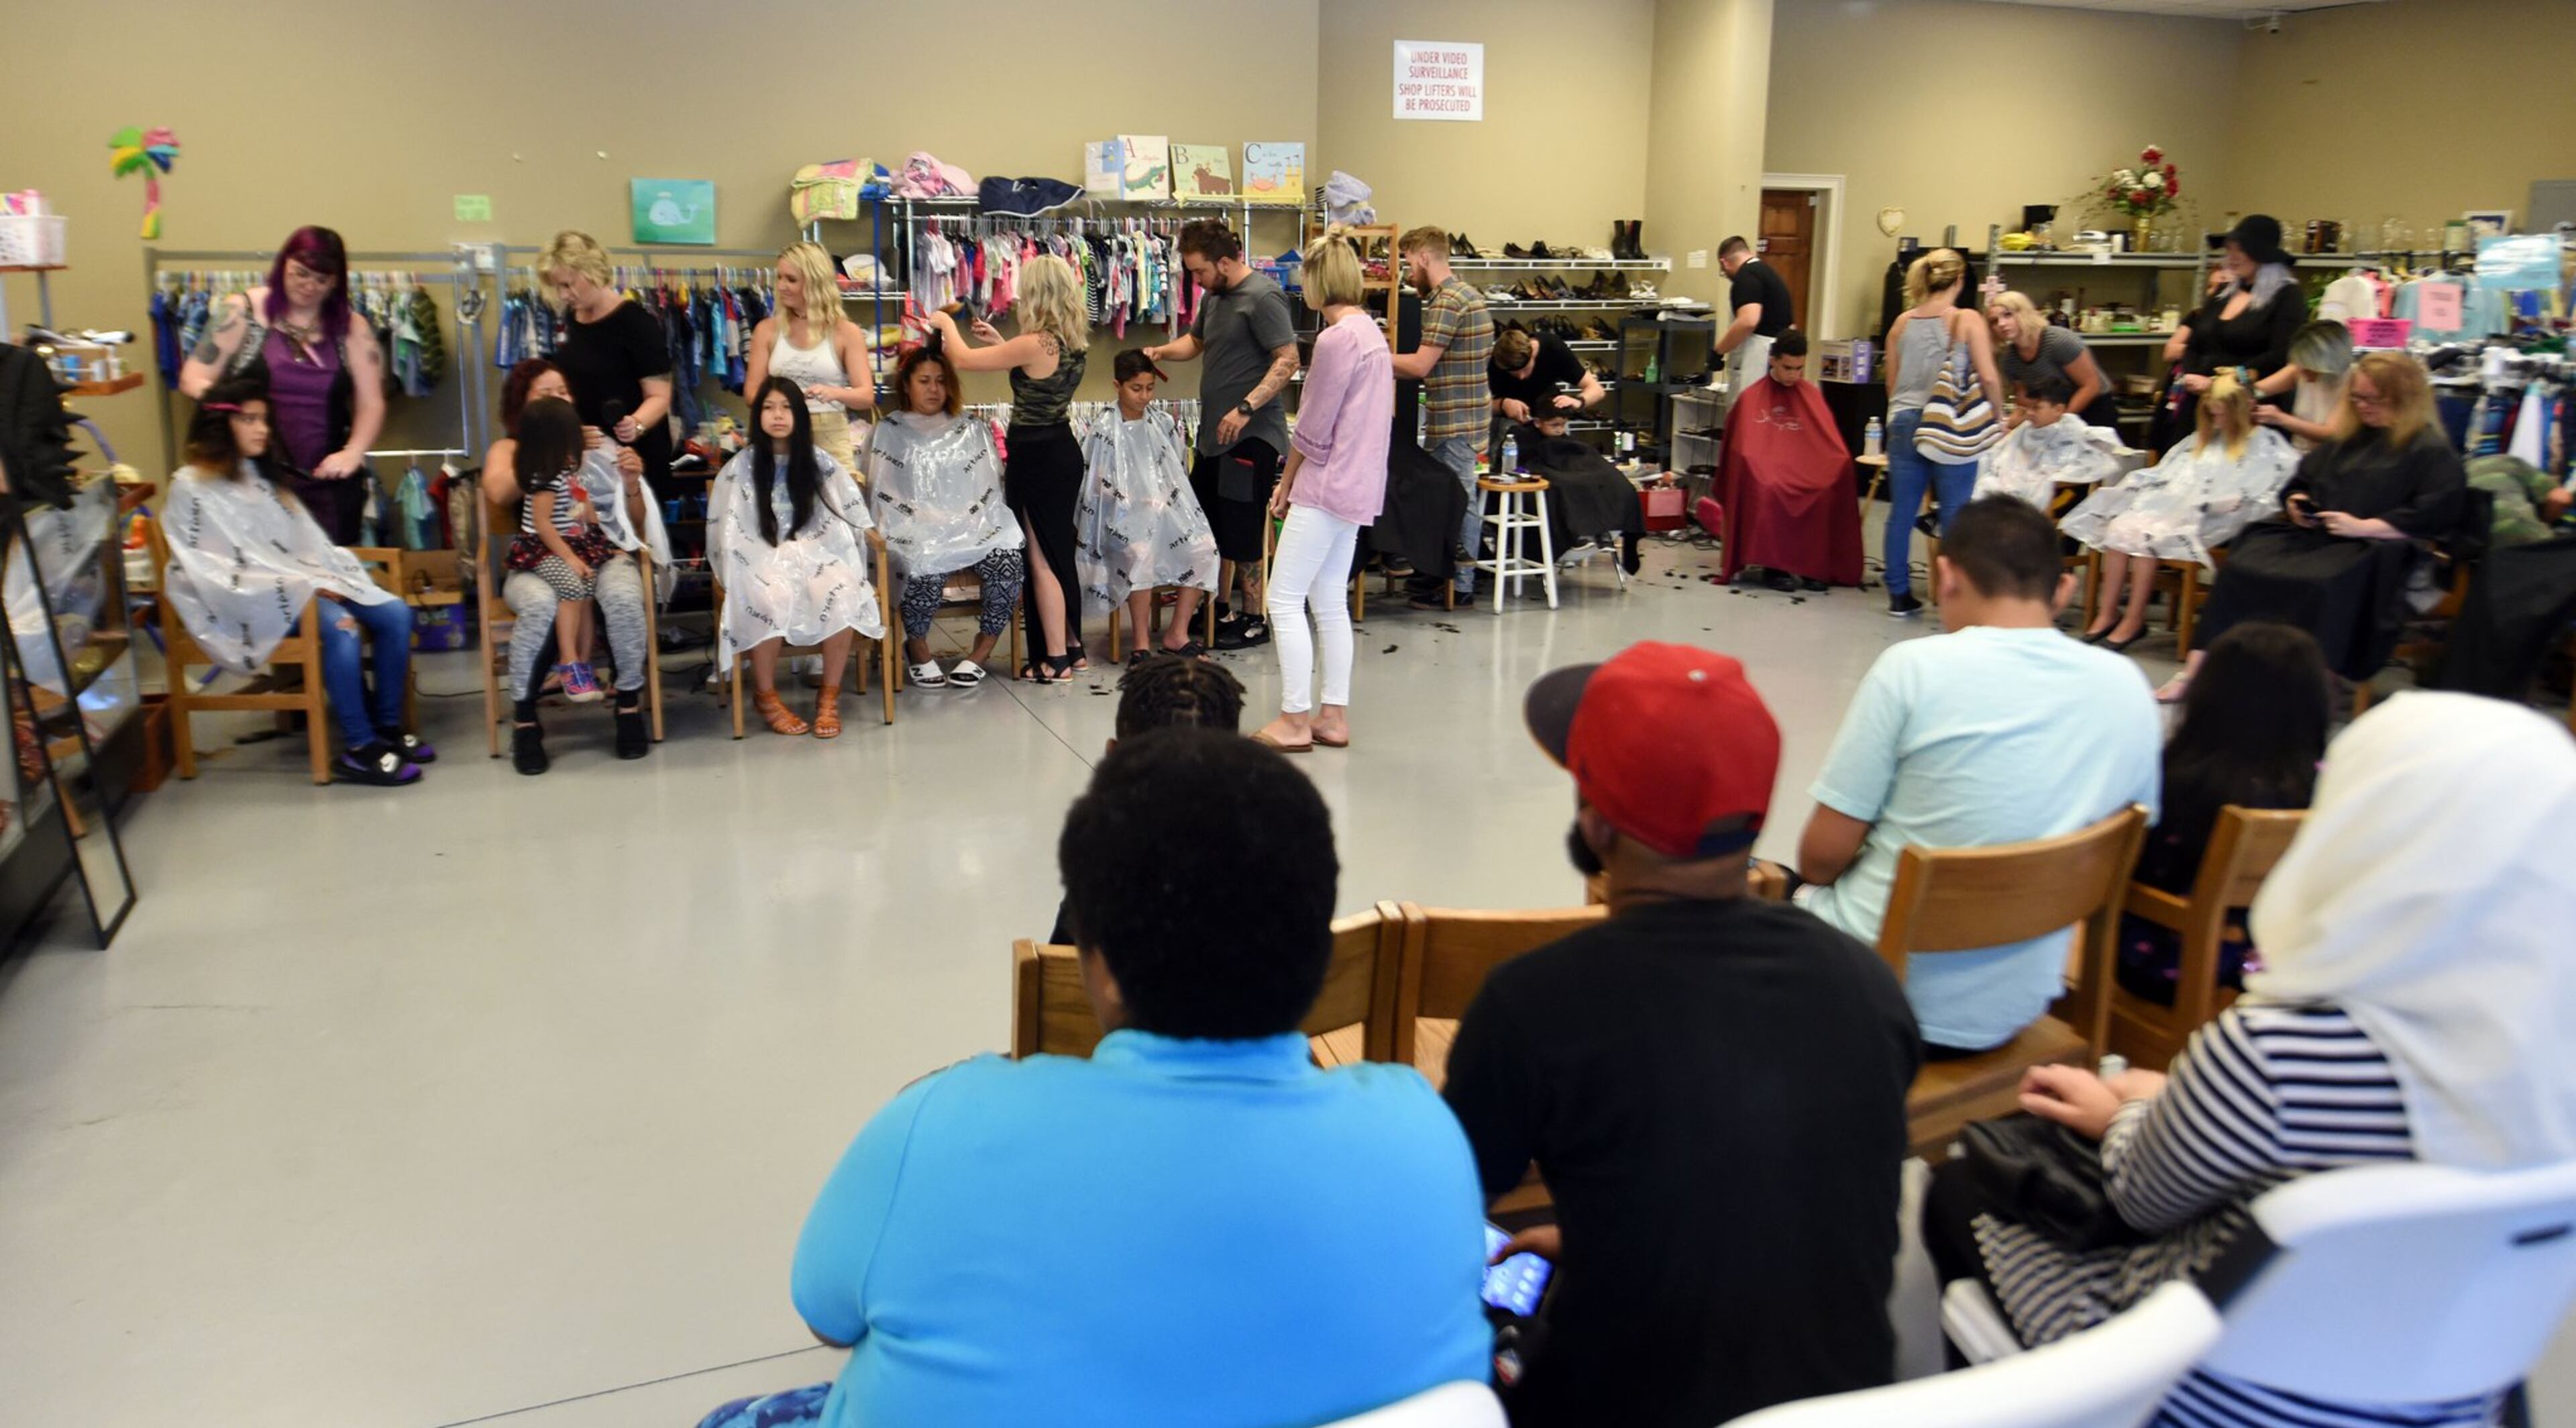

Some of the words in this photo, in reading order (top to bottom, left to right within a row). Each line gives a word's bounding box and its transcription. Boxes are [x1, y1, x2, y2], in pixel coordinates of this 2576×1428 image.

[1411, 51, 1440, 64] UNDER
[1442, 52, 1468, 65] VIDEO
[1409, 66, 1468, 79] SURVEILLANCE
[1399, 83, 1422, 95] SHOP
[1425, 85, 1455, 97] LIFTERS
[1458, 86, 1477, 97] WILL
[1405, 99, 1415, 110] BE
[1418, 99, 1470, 111] PROSECUTED
[1125, 137, 1136, 158] A
[1174, 145, 1189, 164] B
[1245, 143, 1261, 164] C
